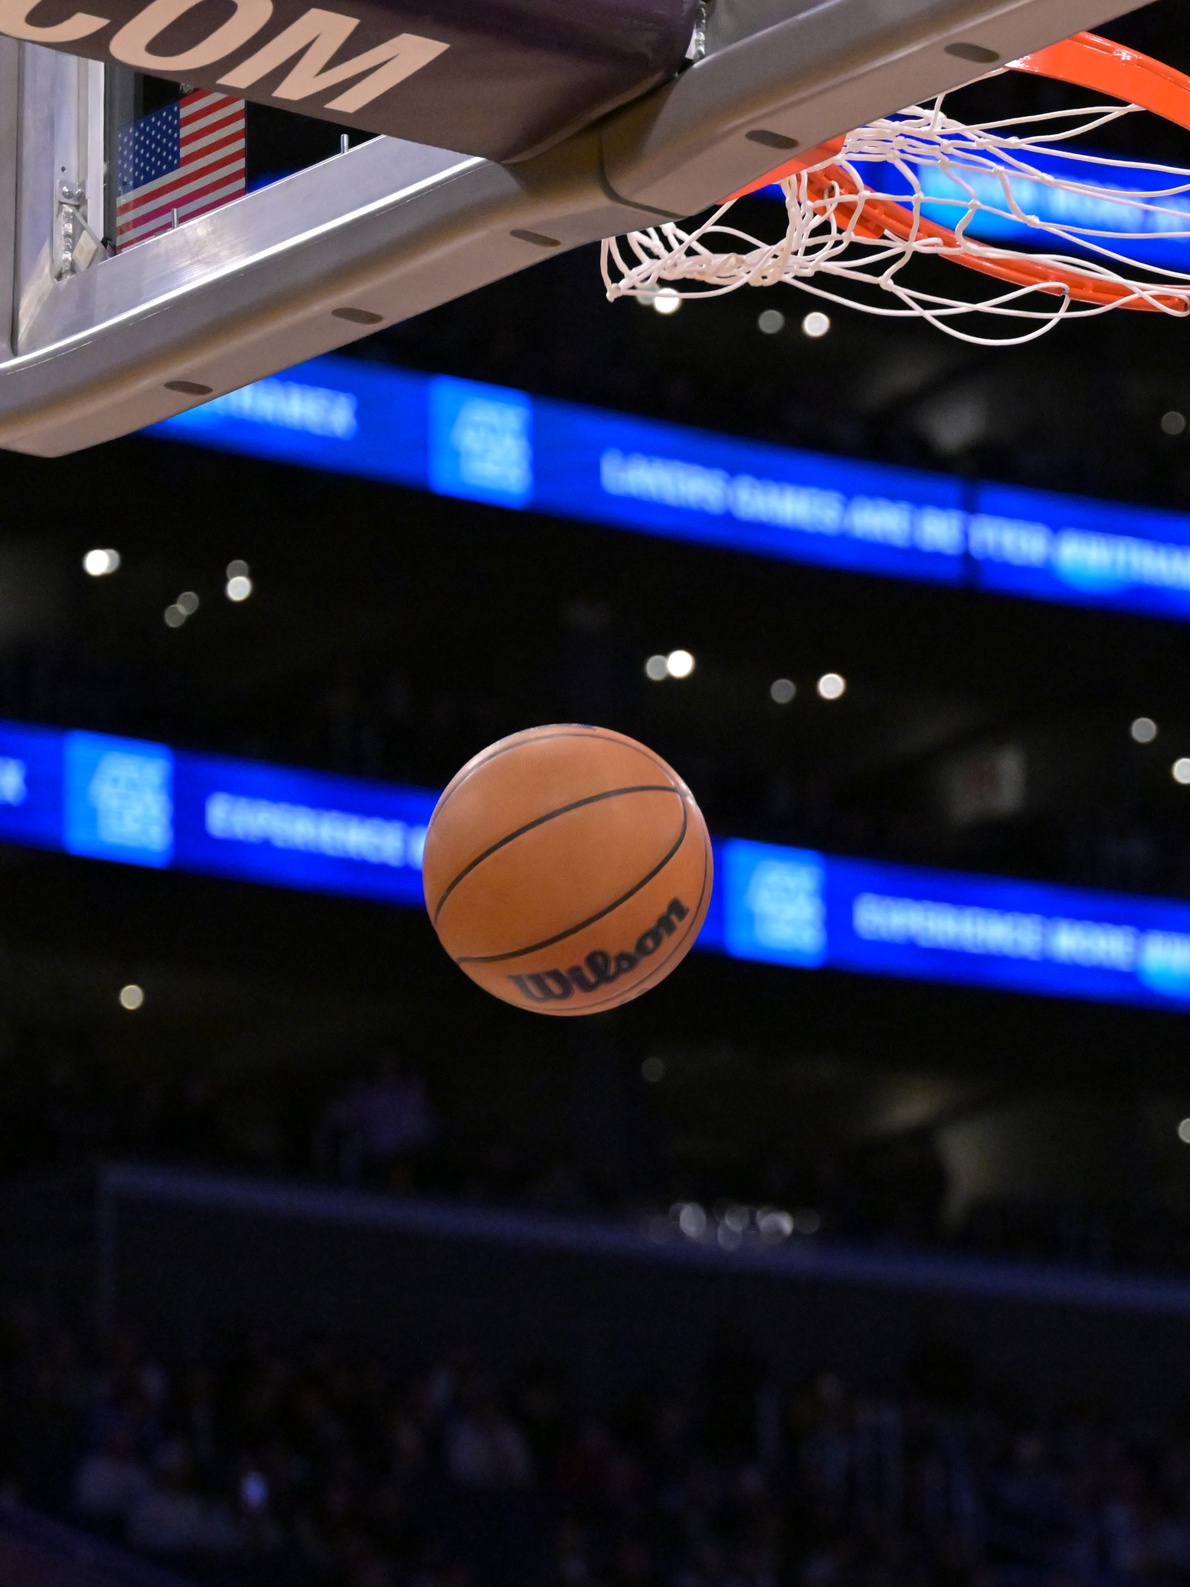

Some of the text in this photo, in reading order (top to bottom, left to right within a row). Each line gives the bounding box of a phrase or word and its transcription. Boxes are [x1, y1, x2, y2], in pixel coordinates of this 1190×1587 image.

[600, 448, 731, 516] LAKERS
[731, 474, 848, 537] GAMES
[204, 791, 406, 868] EXPERIENCE
[506, 896, 690, 1004] Wilson
[852, 891, 1045, 961] EXPERIENCE
[1046, 916, 1137, 973] MORE
